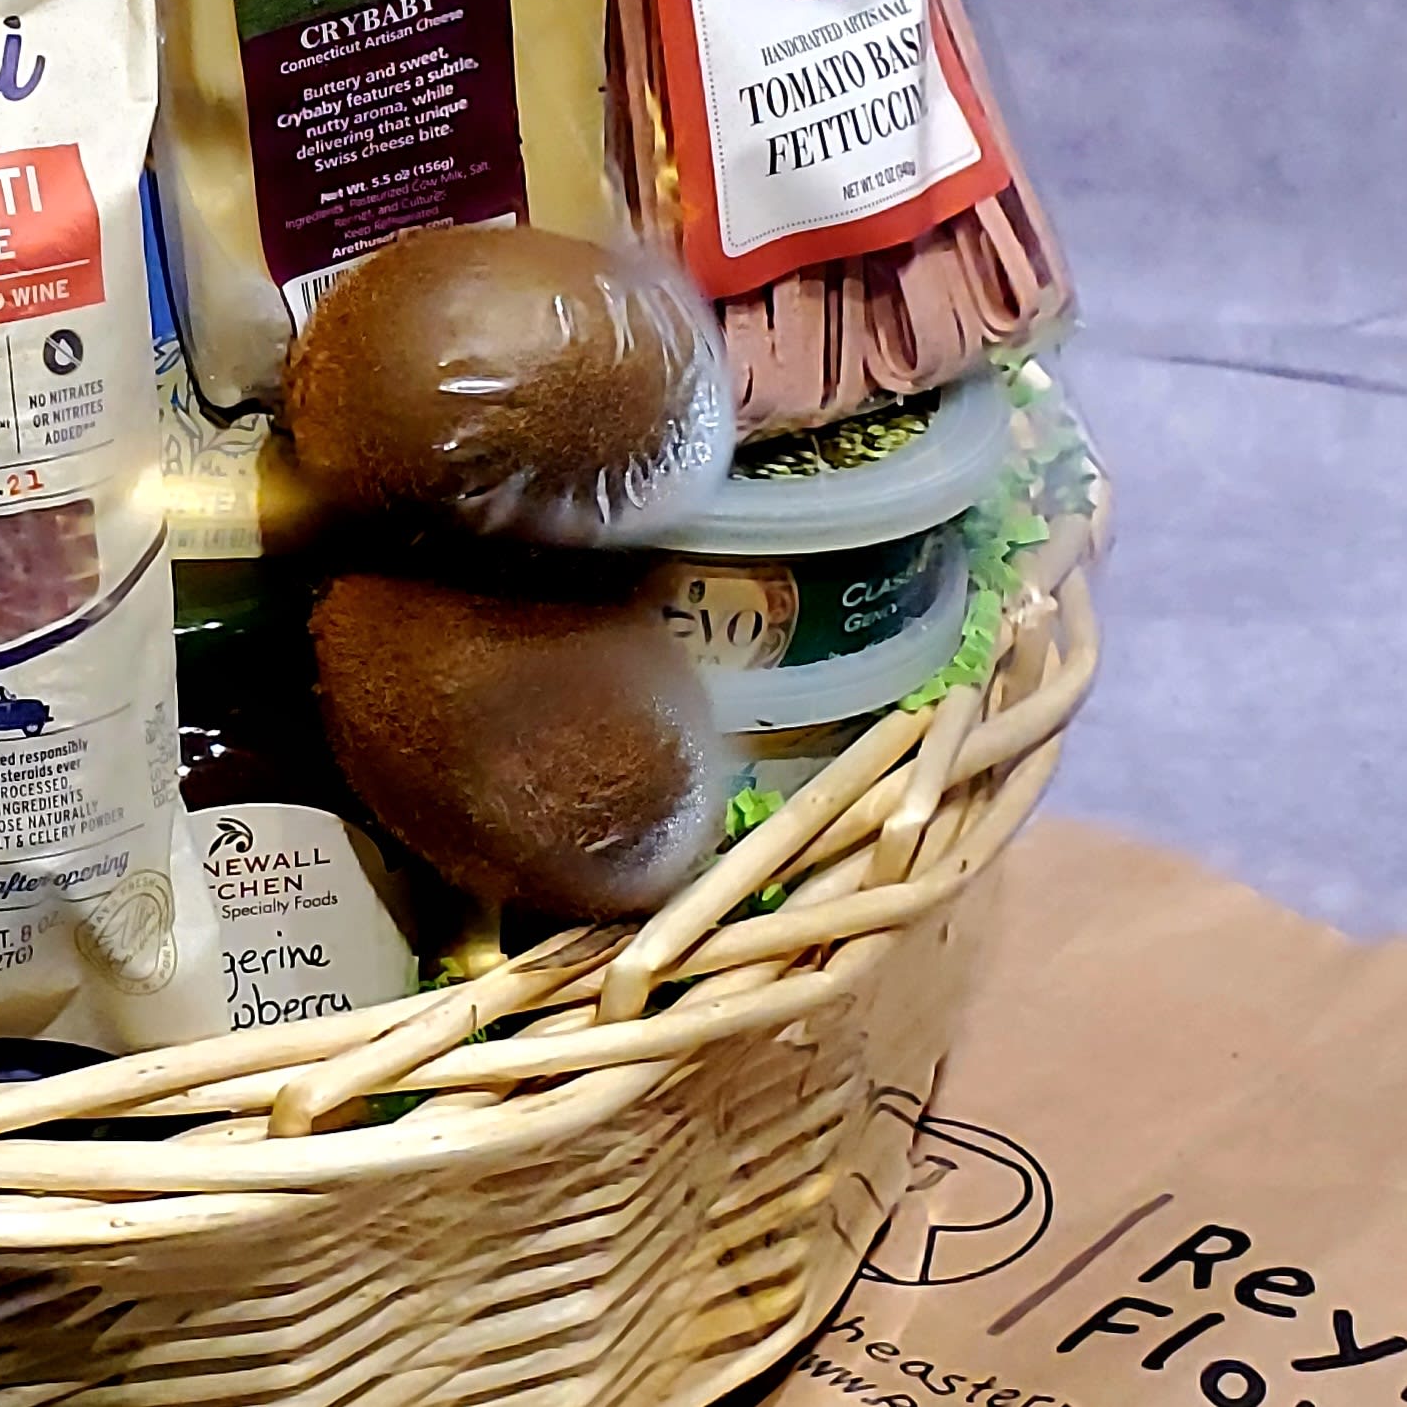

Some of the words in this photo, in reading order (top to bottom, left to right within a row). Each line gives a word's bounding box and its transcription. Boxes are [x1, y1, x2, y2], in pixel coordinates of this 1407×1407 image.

[280, 42, 361, 74] Connecticut
[364, 26, 413, 50] Artisan
[416, 9, 464, 32] Cheese
[761, 22, 843, 67] HANDCRAFTED
[303, 75, 361, 102] Buttery
[365, 63, 396, 84] and
[399, 47, 449, 74] sweet,
[739, 50, 866, 127] TOMATO
[277, 98, 342, 129] Crybaby
[346, 79, 411, 109] features
[415, 76, 424, 88] a
[306, 115, 350, 140] nutty
[353, 102, 408, 126] aroma,
[412, 83, 454, 107] while
[296, 128, 374, 161] delivering
[378, 115, 412, 135] that
[415, 98, 469, 125] unique
[315, 149, 358, 173] Swiss
[361, 132, 415, 158] cheese
[419, 123, 455, 142] bite.
[346, 182, 369, 196] Wt.
[371, 174, 391, 188] 5.5
[413, 157, 454, 177] (156g)
[843, 181, 860, 201] NET
[11, 279, 70, 307] WINE
[28, 394, 46, 409] NO
[50, 379, 104, 404] NITRATES
[33, 413, 50, 428] OR
[53, 400, 104, 423] NITRITES
[1, 765, 53, 783] steroids
[56, 758, 82, 774] ever
[19, 738, 88, 765] responsibly
[16, 835, 24, 848] &
[29, 825, 76, 846] CELERY
[81, 807, 124, 834] POWDER
[28, 800, 98, 829] NATURALLY
[53, 850, 130, 891] opening
[209, 874, 303, 901] CHEN
[222, 898, 289, 922] Specialty
[294, 890, 338, 910] Foods
[20, 924, 32, 942] 8
